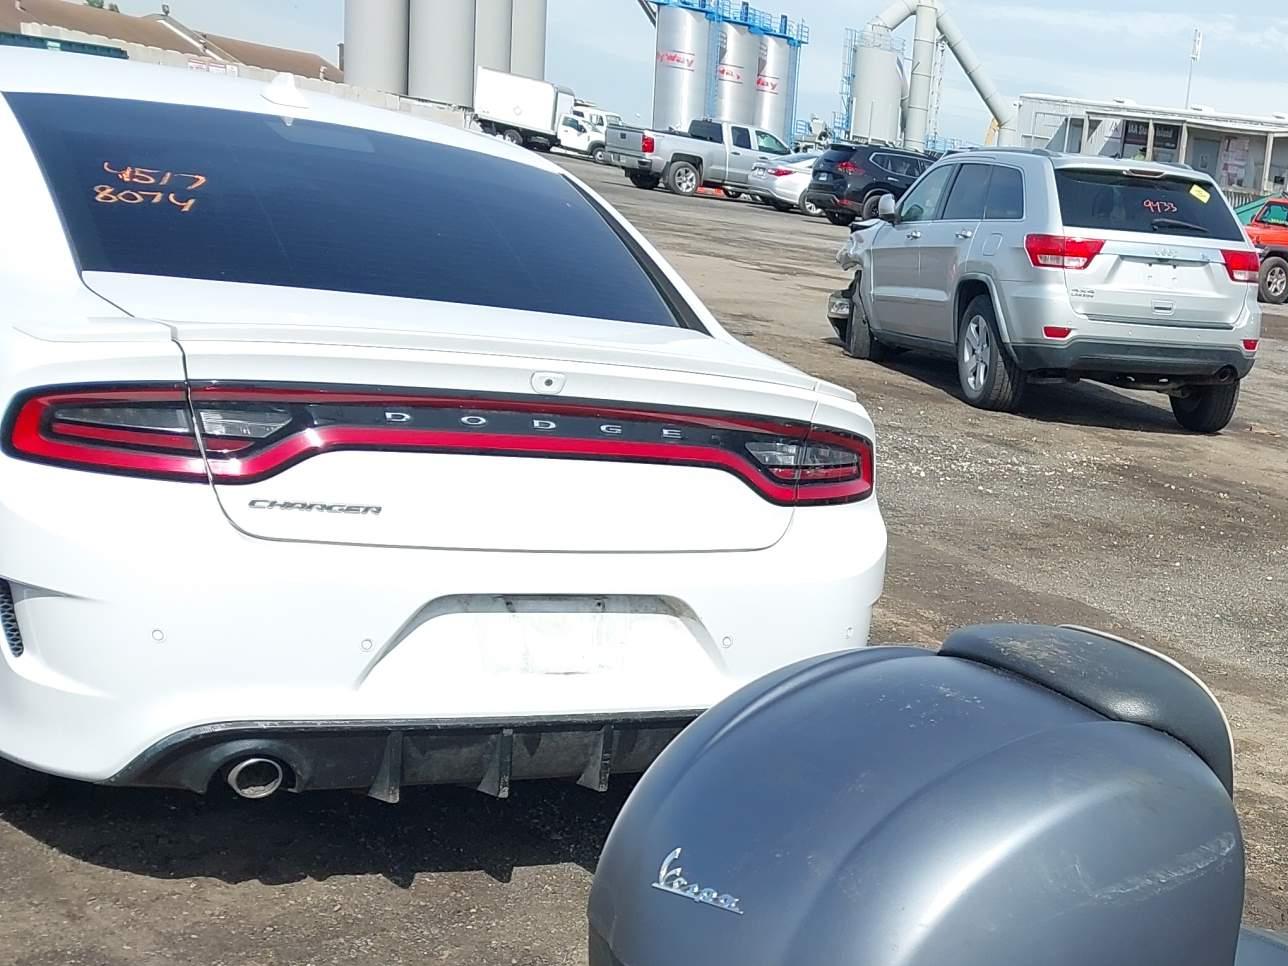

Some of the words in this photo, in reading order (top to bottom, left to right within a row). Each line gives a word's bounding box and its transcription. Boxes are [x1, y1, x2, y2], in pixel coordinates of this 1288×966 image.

[104, 161, 207, 191] 4517
[93, 184, 197, 212] 8074
[384, 410, 686, 441] DODGE
[248, 499, 382, 516] CHARGER
[651, 847, 744, 915] Vespa
